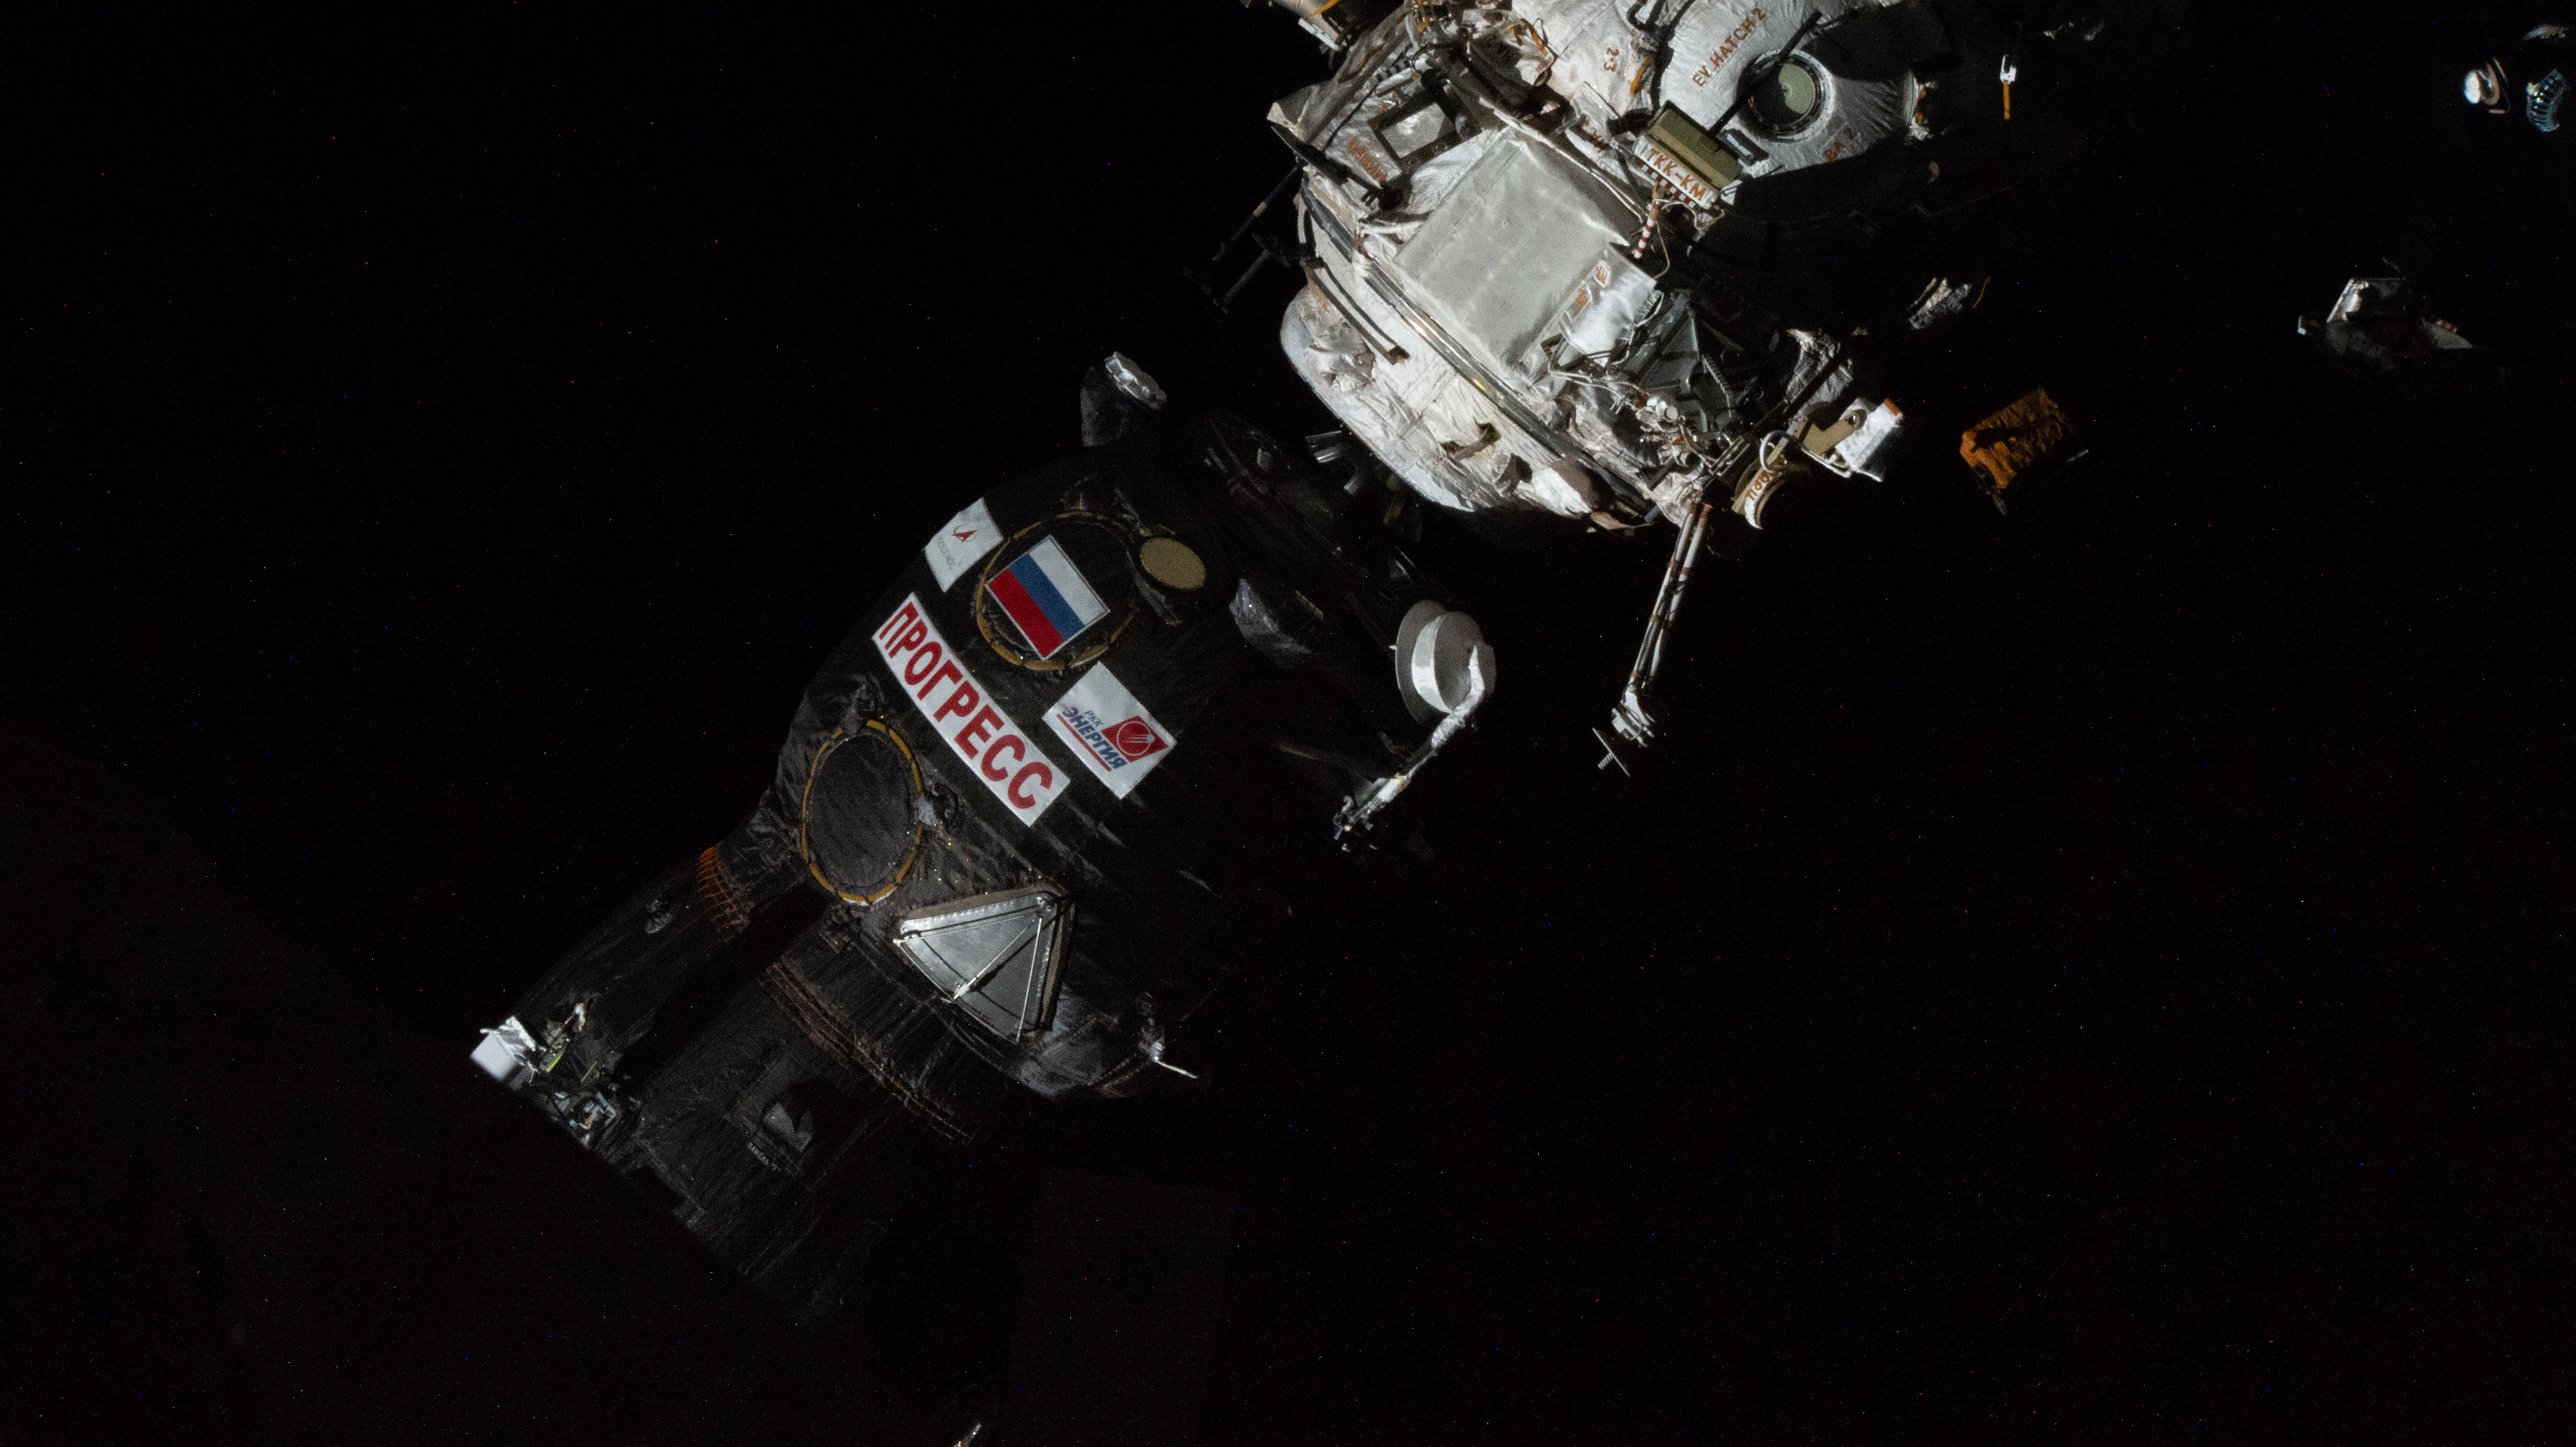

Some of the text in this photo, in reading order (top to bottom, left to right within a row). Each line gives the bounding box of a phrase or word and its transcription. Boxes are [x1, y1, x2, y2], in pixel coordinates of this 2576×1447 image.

[1692, 7, 1766, 87] EV HATCH 2
[878, 601, 1053, 810] ПРОГРЕСС
[1061, 706, 1128, 770] ЭНЕРГИЯ
[1084, 709, 1104, 727] РКК
